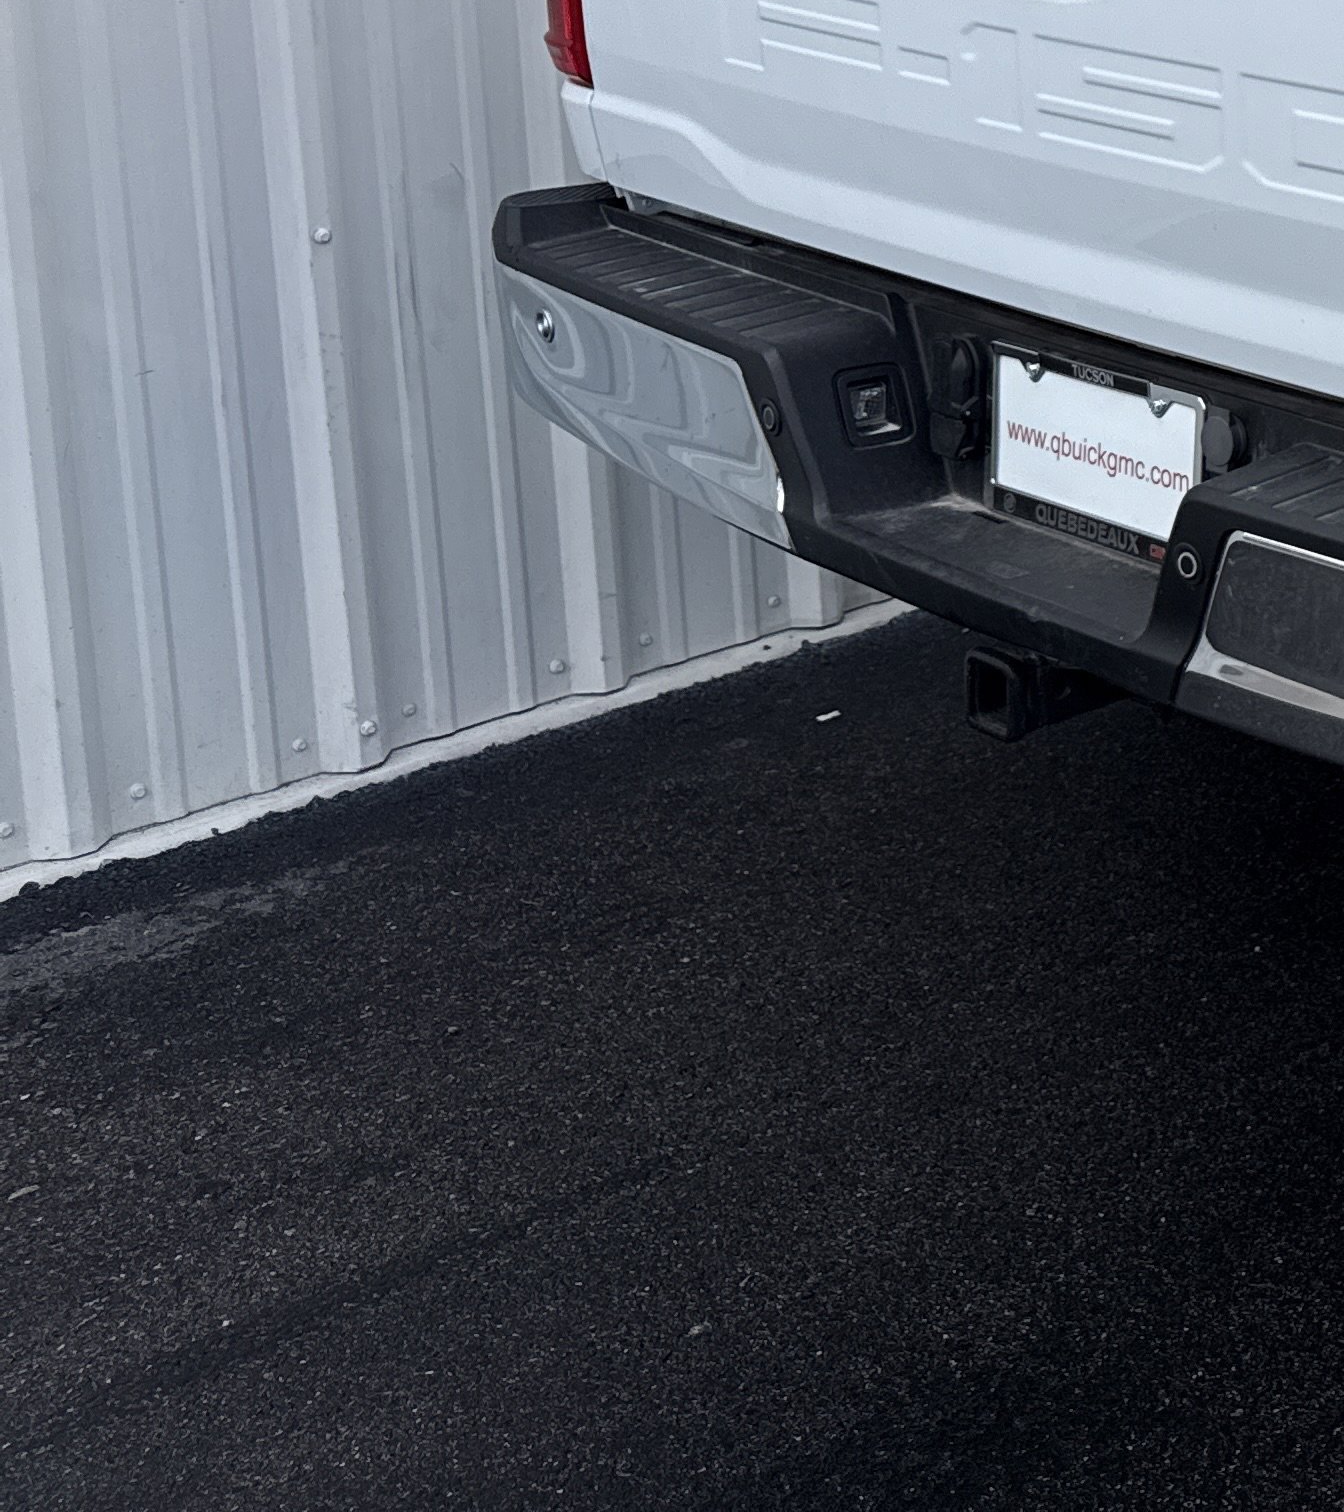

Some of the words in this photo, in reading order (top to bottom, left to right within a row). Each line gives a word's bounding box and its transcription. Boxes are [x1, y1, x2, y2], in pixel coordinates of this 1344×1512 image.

[1071, 363, 1115, 387] TUCSON
[1006, 419, 1190, 491] www.qbuickgmc.com
[1034, 506, 1140, 555] QUEBEDEAUX
